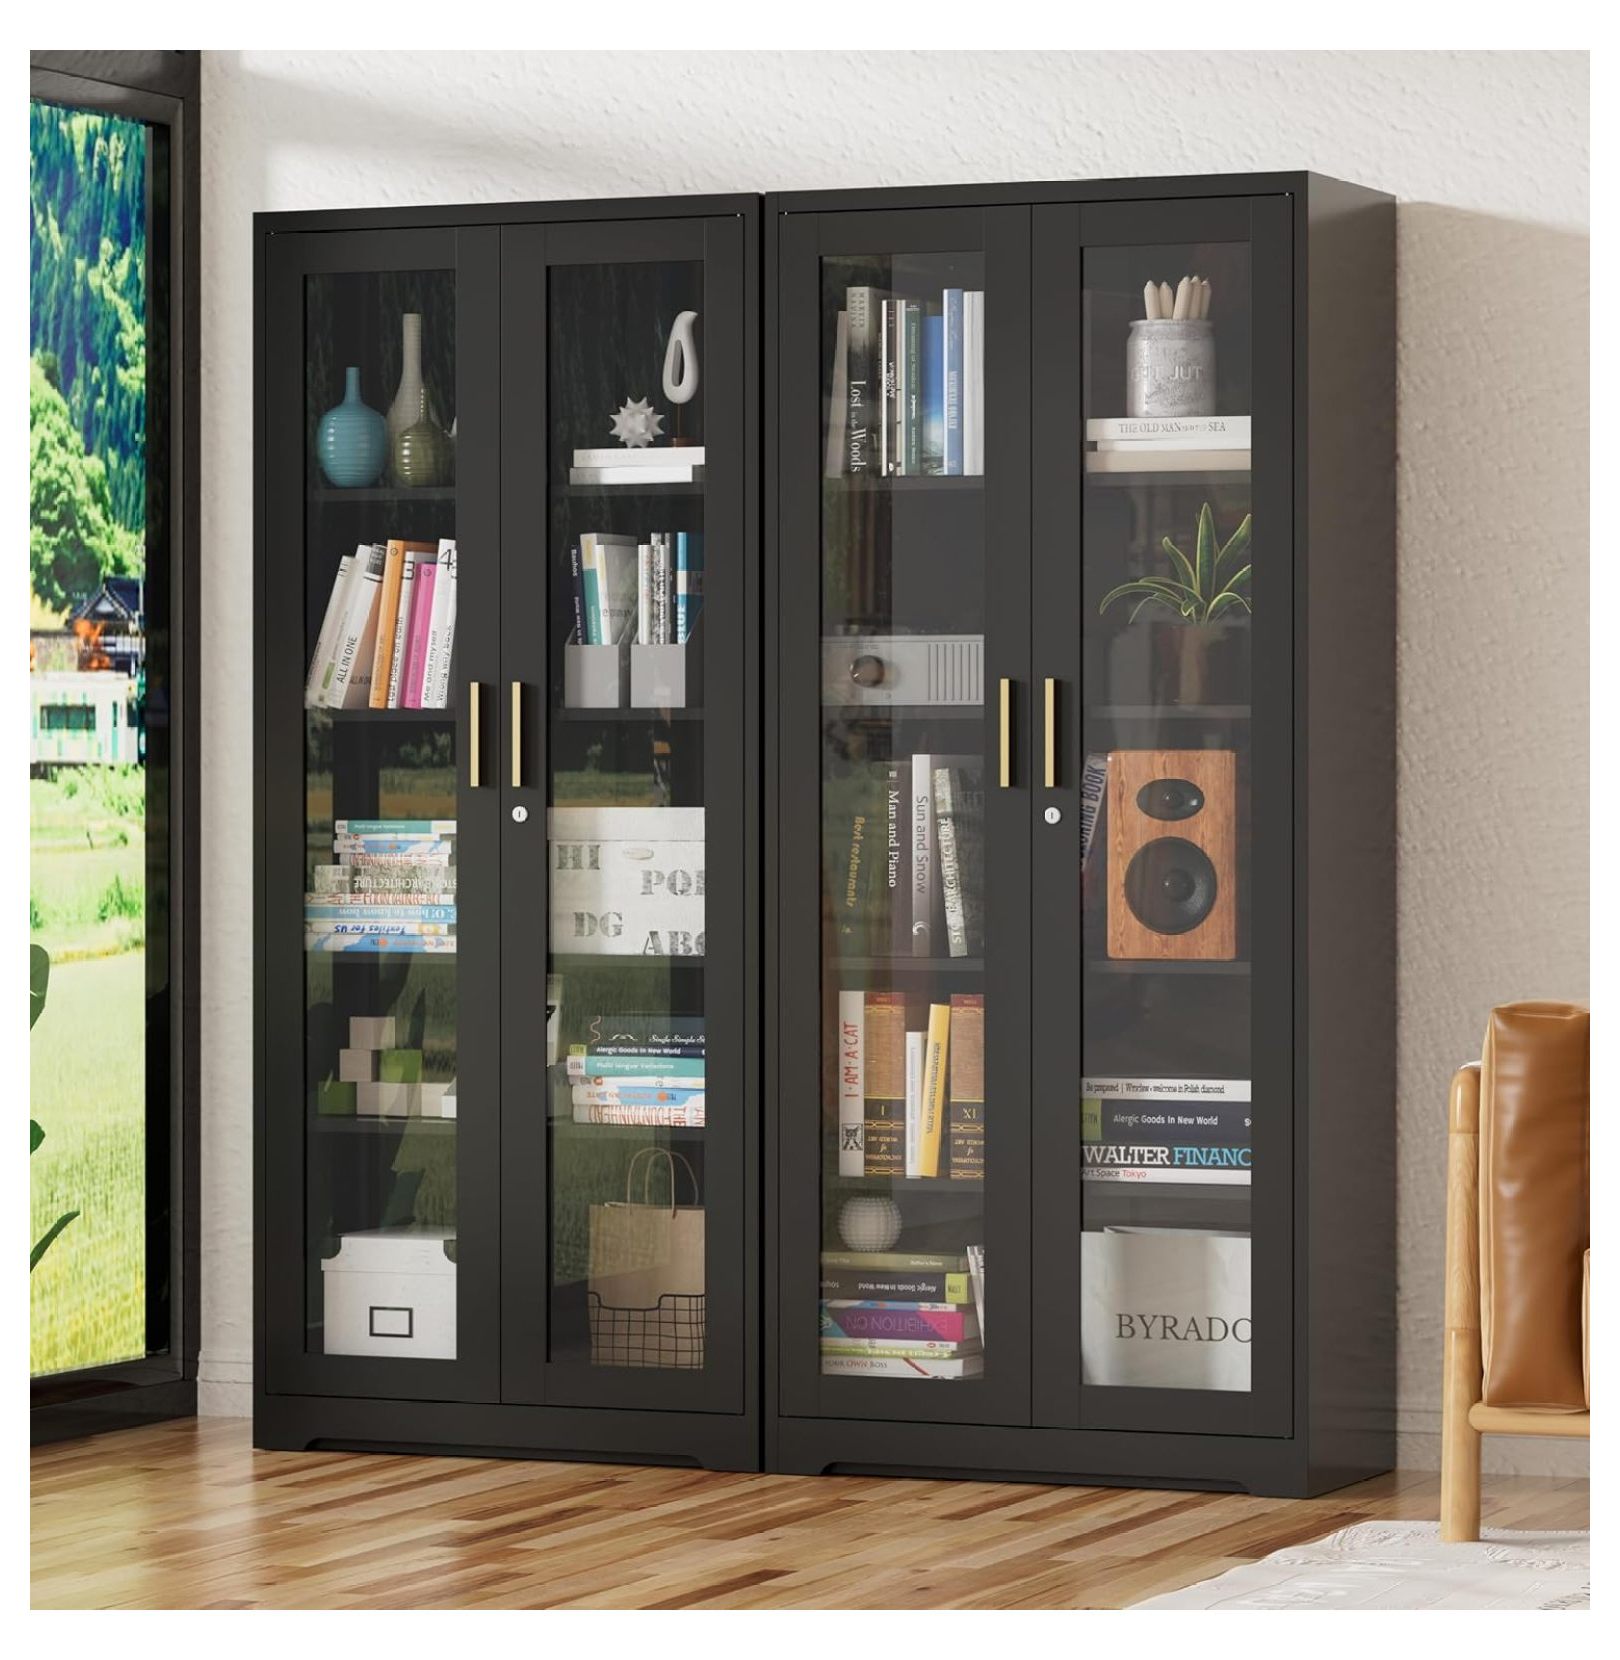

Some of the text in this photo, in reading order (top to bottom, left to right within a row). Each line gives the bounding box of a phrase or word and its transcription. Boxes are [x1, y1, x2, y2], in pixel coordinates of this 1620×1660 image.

[850, 380, 866, 407] Lost
[1119, 423, 1138, 433] THE
[1139, 423, 1159, 433] OLD
[1161, 423, 1181, 433] MAN
[1208, 422, 1226, 432] SEA
[850, 429, 866, 472] Woods
[336, 635, 358, 683] ALL IN ONE
[426, 664, 434, 683] and
[424, 686, 432, 702] Me
[1083, 765, 1107, 802] BOOK
[888, 790, 899, 888] Man and Piano
[916, 796, 928, 894] Sun and Snow
[556, 845, 600, 870] HI
[845, 816, 865, 908] Best restaurants
[938, 818, 960, 902] ARCHITECTURE
[353, 878, 424, 888] ARCHITECTURE
[334, 925, 406, 935] Textiles for US
[573, 912, 623, 937] DG
[1113, 1114, 1218, 1126] Alergic Goods In New World
[1083, 1146, 1251, 1166] WALTER FINANC
[1096, 1169, 1120, 1177] Space
[1122, 1169, 1147, 1178] Tokyo
[1116, 1313, 1251, 1343] BYRADO
